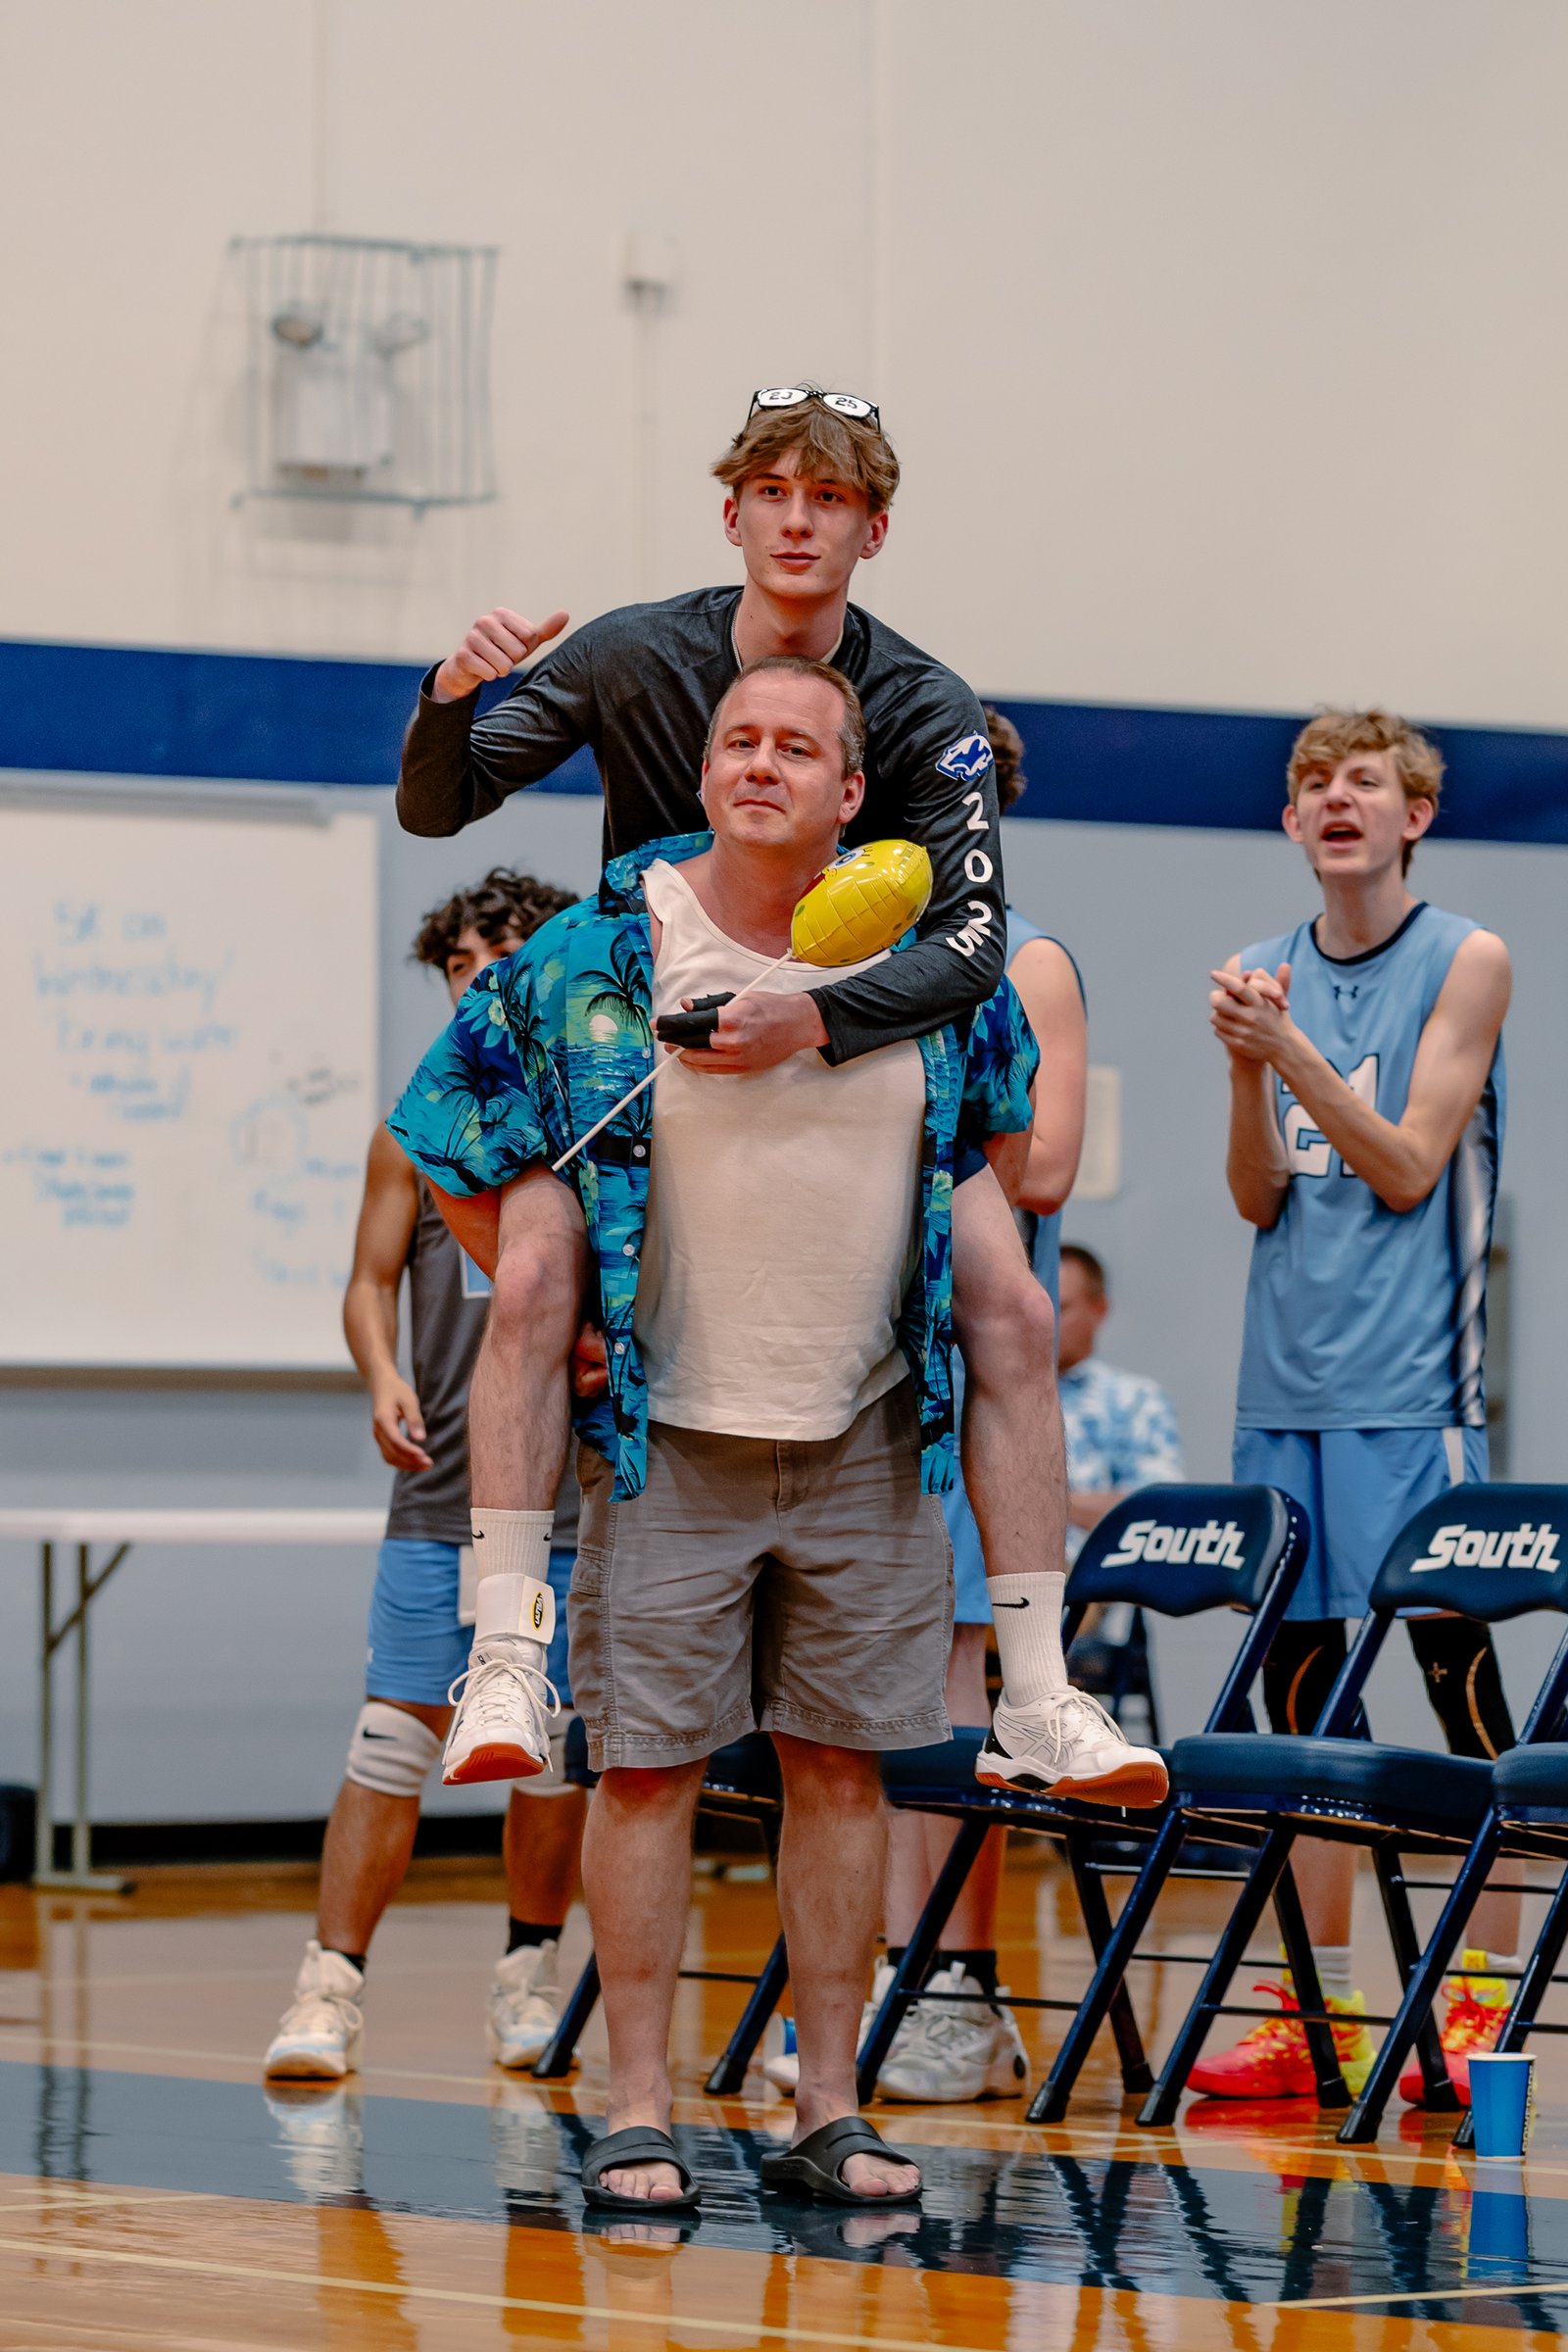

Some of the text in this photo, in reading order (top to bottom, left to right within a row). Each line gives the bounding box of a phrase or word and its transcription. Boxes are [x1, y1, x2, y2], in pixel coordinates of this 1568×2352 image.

[834, 397, 858, 410] 25
[945, 791, 993, 957] 2025
[1101, 1519, 1246, 1570] South
[1409, 1523, 1561, 1574] South
